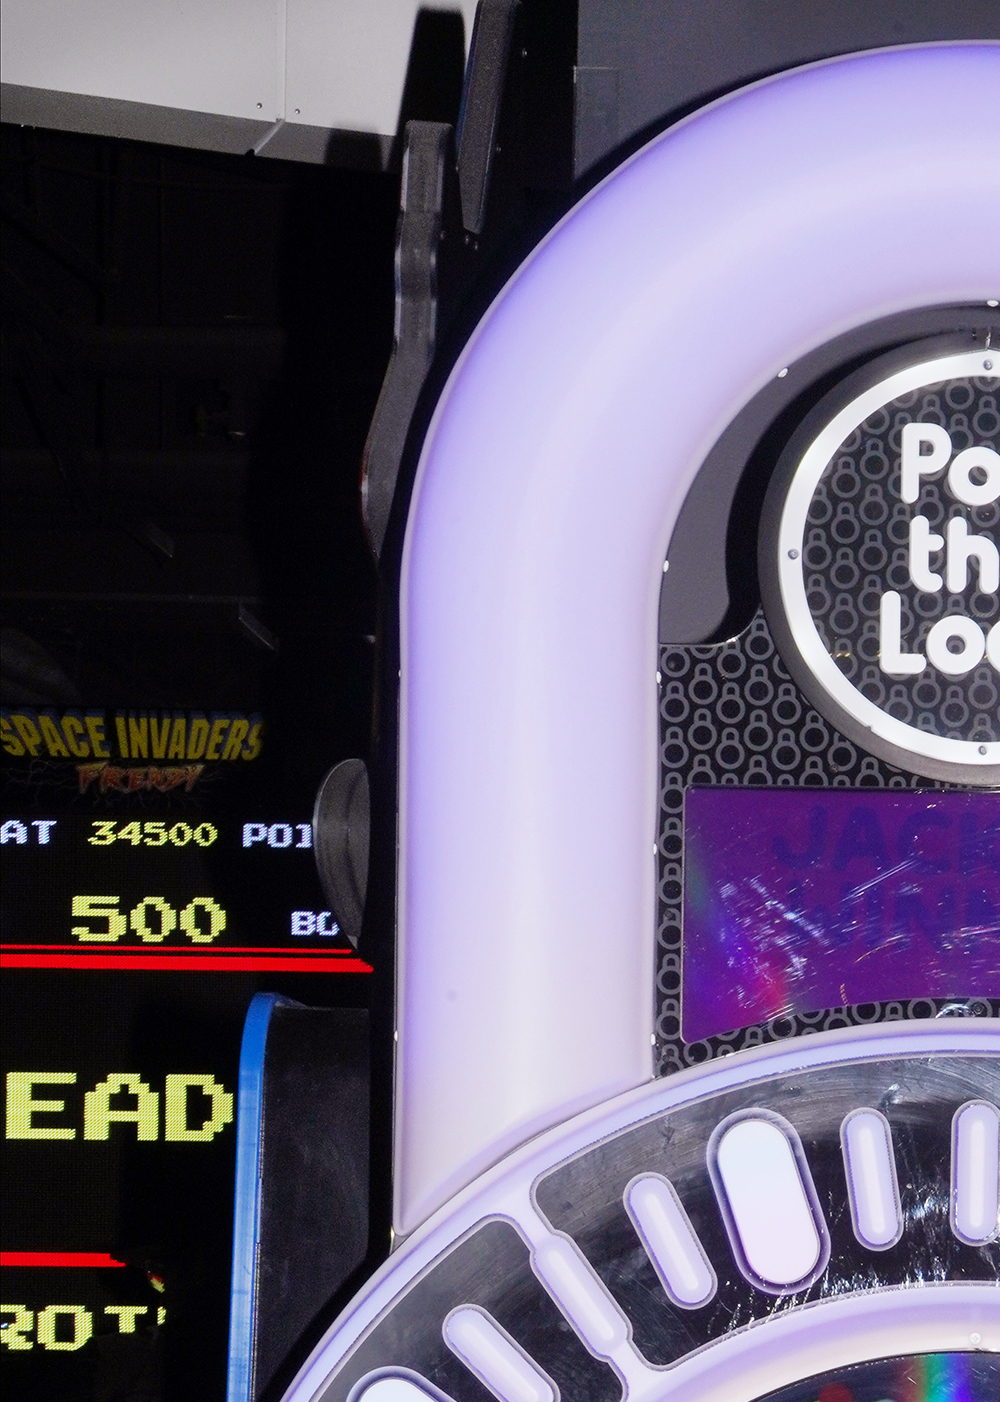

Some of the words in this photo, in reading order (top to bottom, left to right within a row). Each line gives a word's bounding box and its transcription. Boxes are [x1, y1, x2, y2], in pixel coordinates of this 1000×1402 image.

[0, 710, 111, 759] SPACE
[114, 711, 264, 761] INVADERS
[76, 761, 206, 794] FRENZY
[0, 819, 57, 845] AT
[87, 820, 219, 847] 34500
[71, 895, 227, 944] 500
[5, 1071, 234, 1142] EAD
